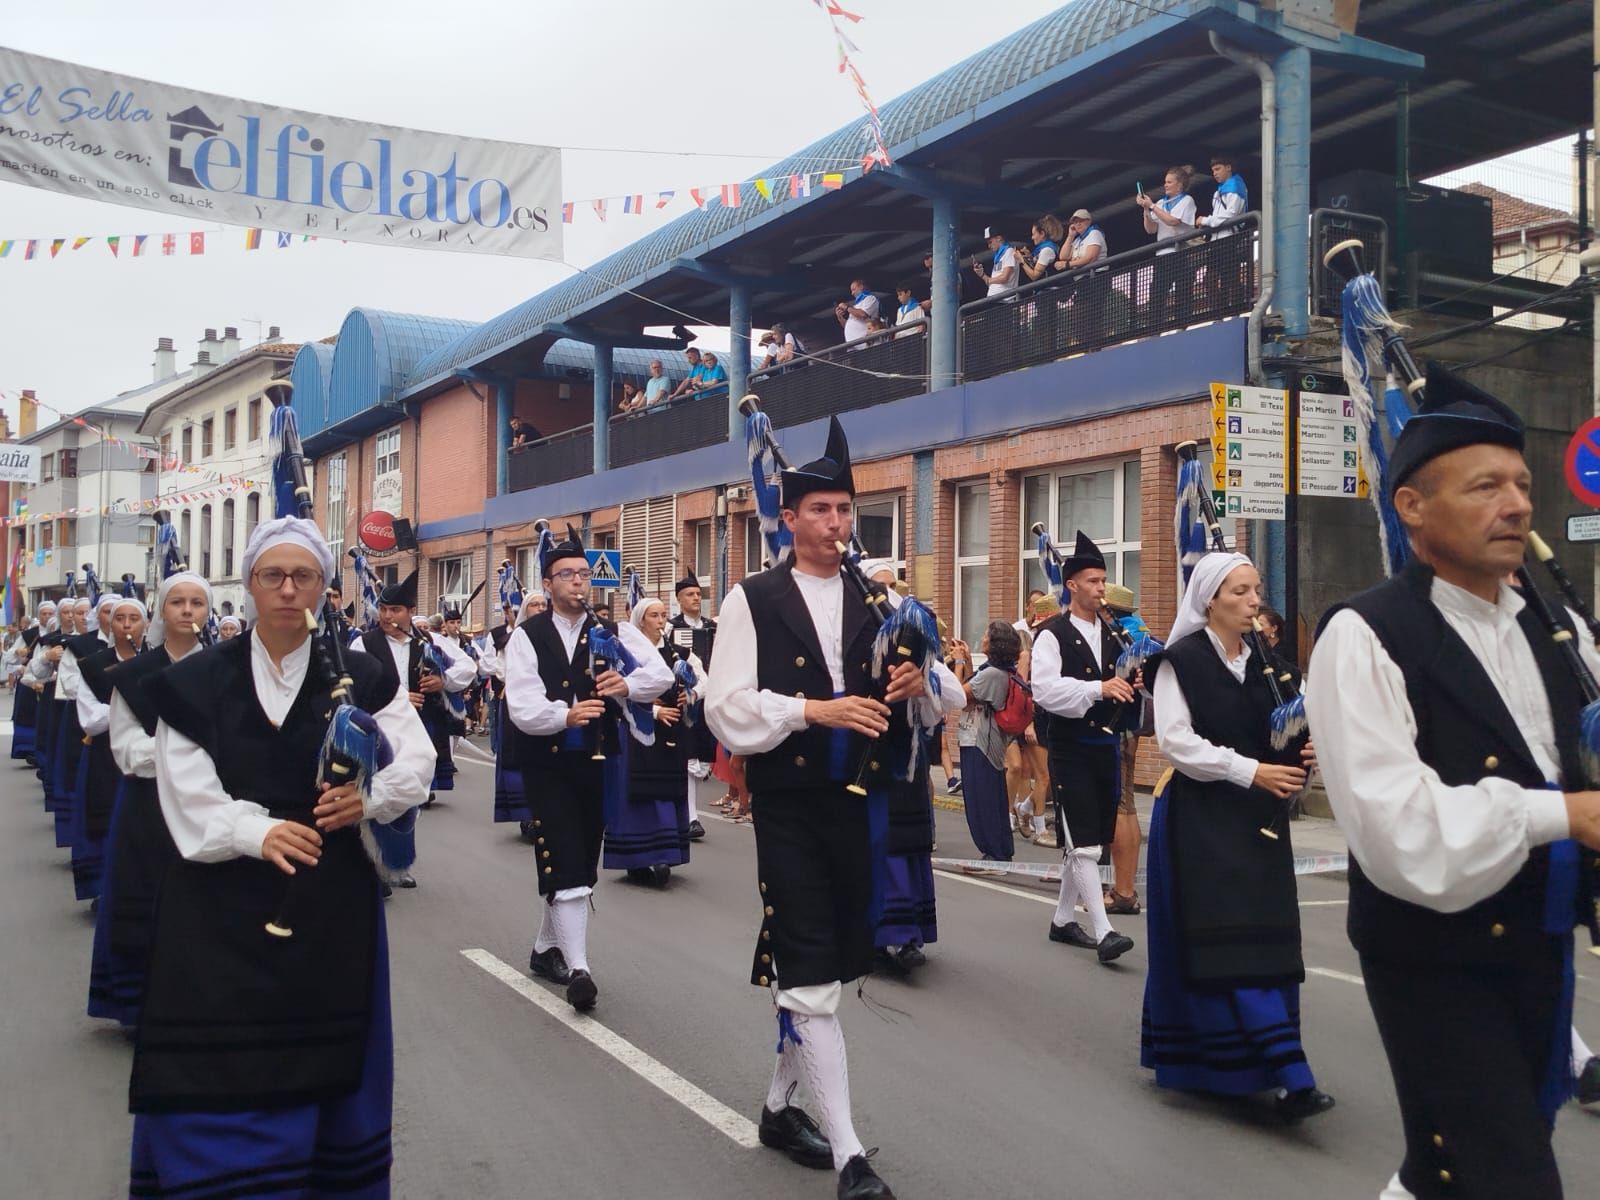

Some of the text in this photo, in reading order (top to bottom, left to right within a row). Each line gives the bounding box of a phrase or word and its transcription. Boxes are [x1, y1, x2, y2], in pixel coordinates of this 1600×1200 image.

[0, 82, 153, 124] El Sella
[0, 125, 152, 167] nosotros en:
[68, 174, 86, 184] en
[96, 180, 114, 190] un
[124, 185, 160, 200] solo
[169, 193, 214, 209] click
[193, 114, 549, 233] elfielato.es
[255, 205, 267, 220] Y
[382, 223, 475, 245] NORA
[1268, 451, 1284, 459] Sella
[1252, 506, 1284, 514] Concordia
